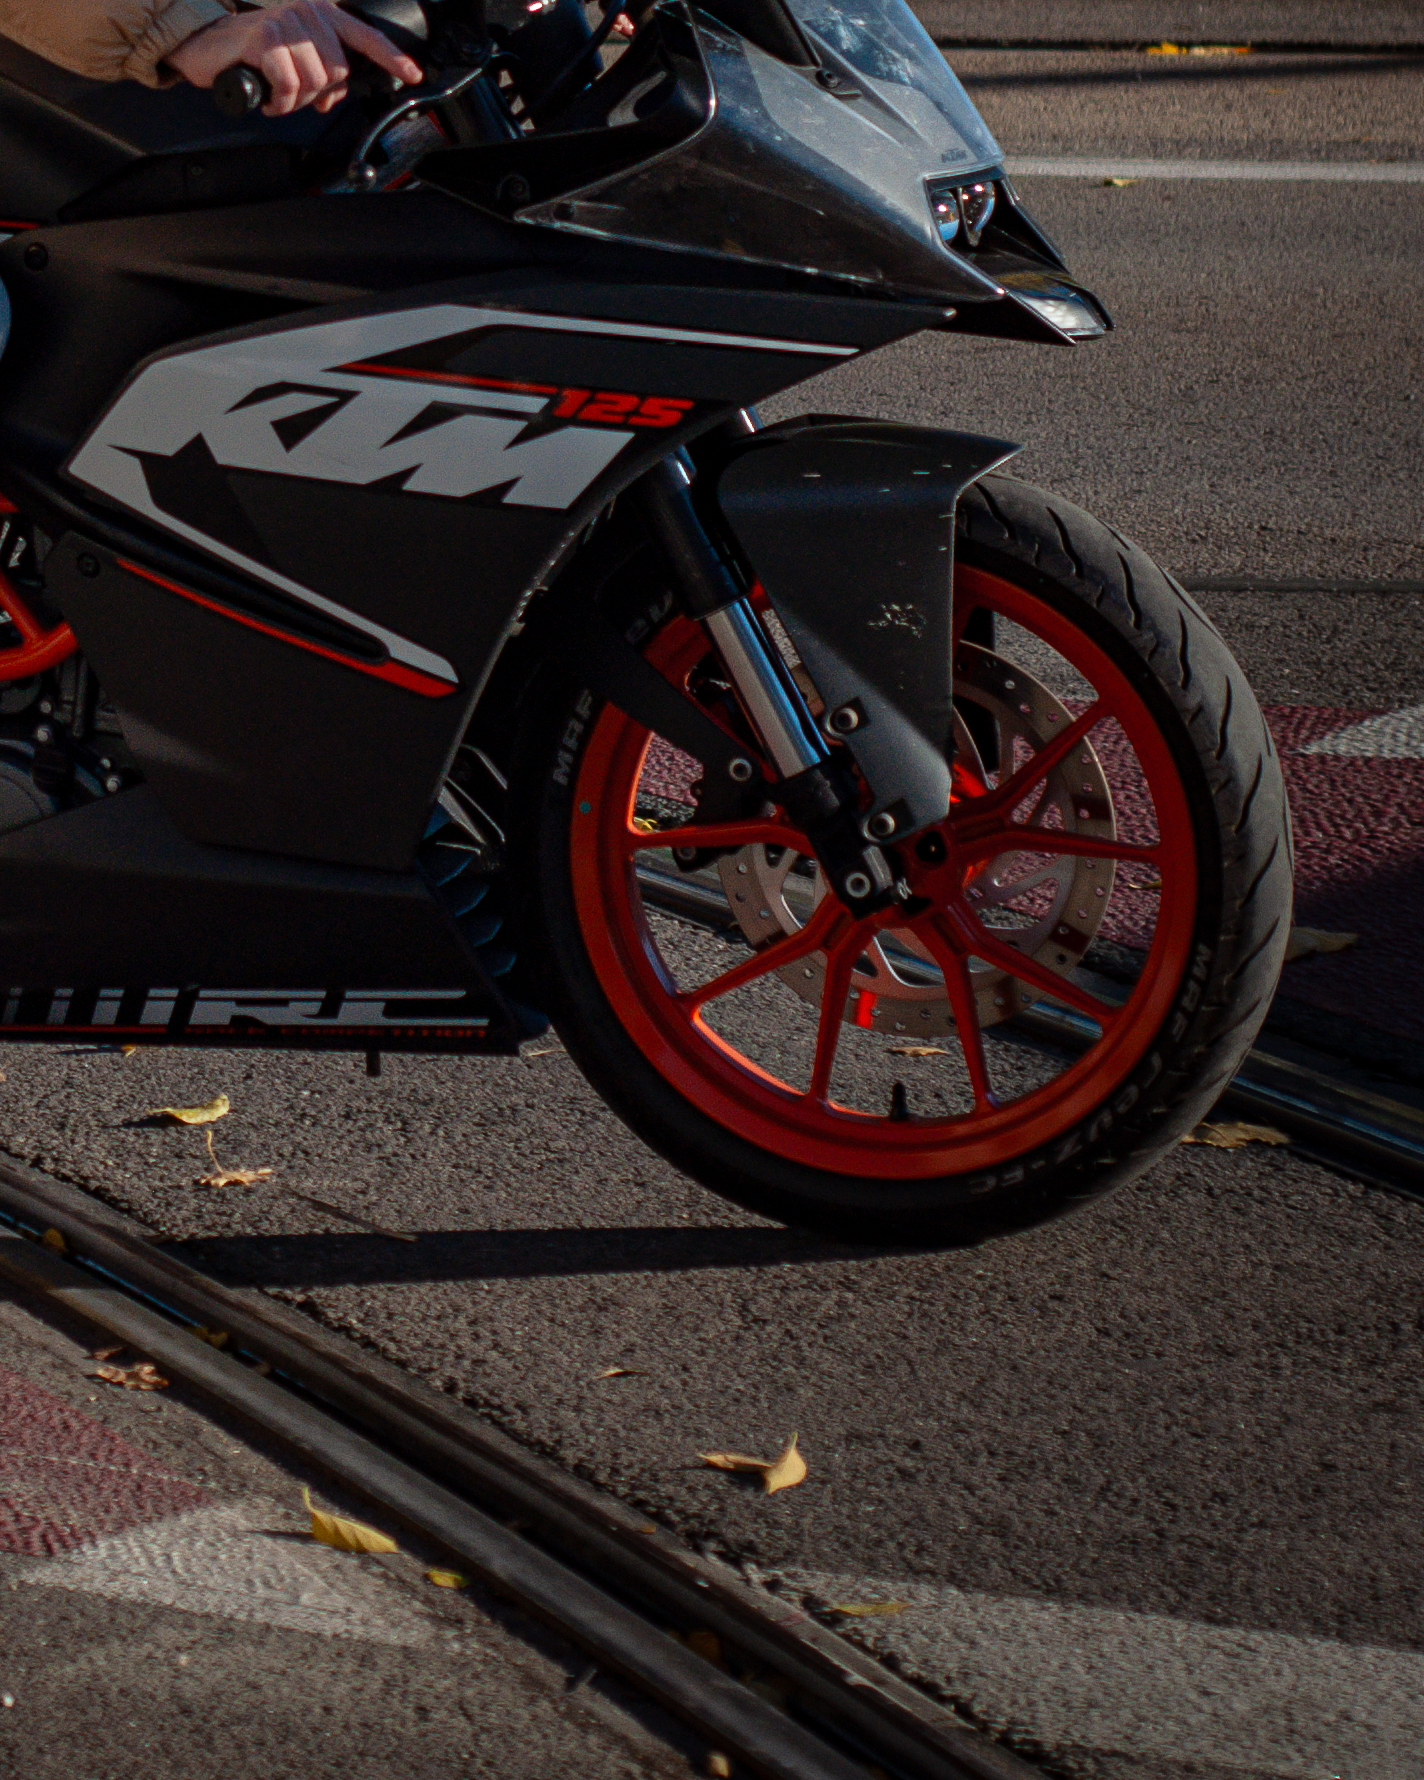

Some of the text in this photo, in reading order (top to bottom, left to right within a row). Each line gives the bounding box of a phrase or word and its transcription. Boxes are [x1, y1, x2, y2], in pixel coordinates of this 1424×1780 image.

[96, 355, 636, 510] KTM
[552, 388, 695, 427] 125
[552, 687, 593, 786] MRF
[188, 989, 490, 1026] RC
[1170, 942, 1213, 1043] MRF
